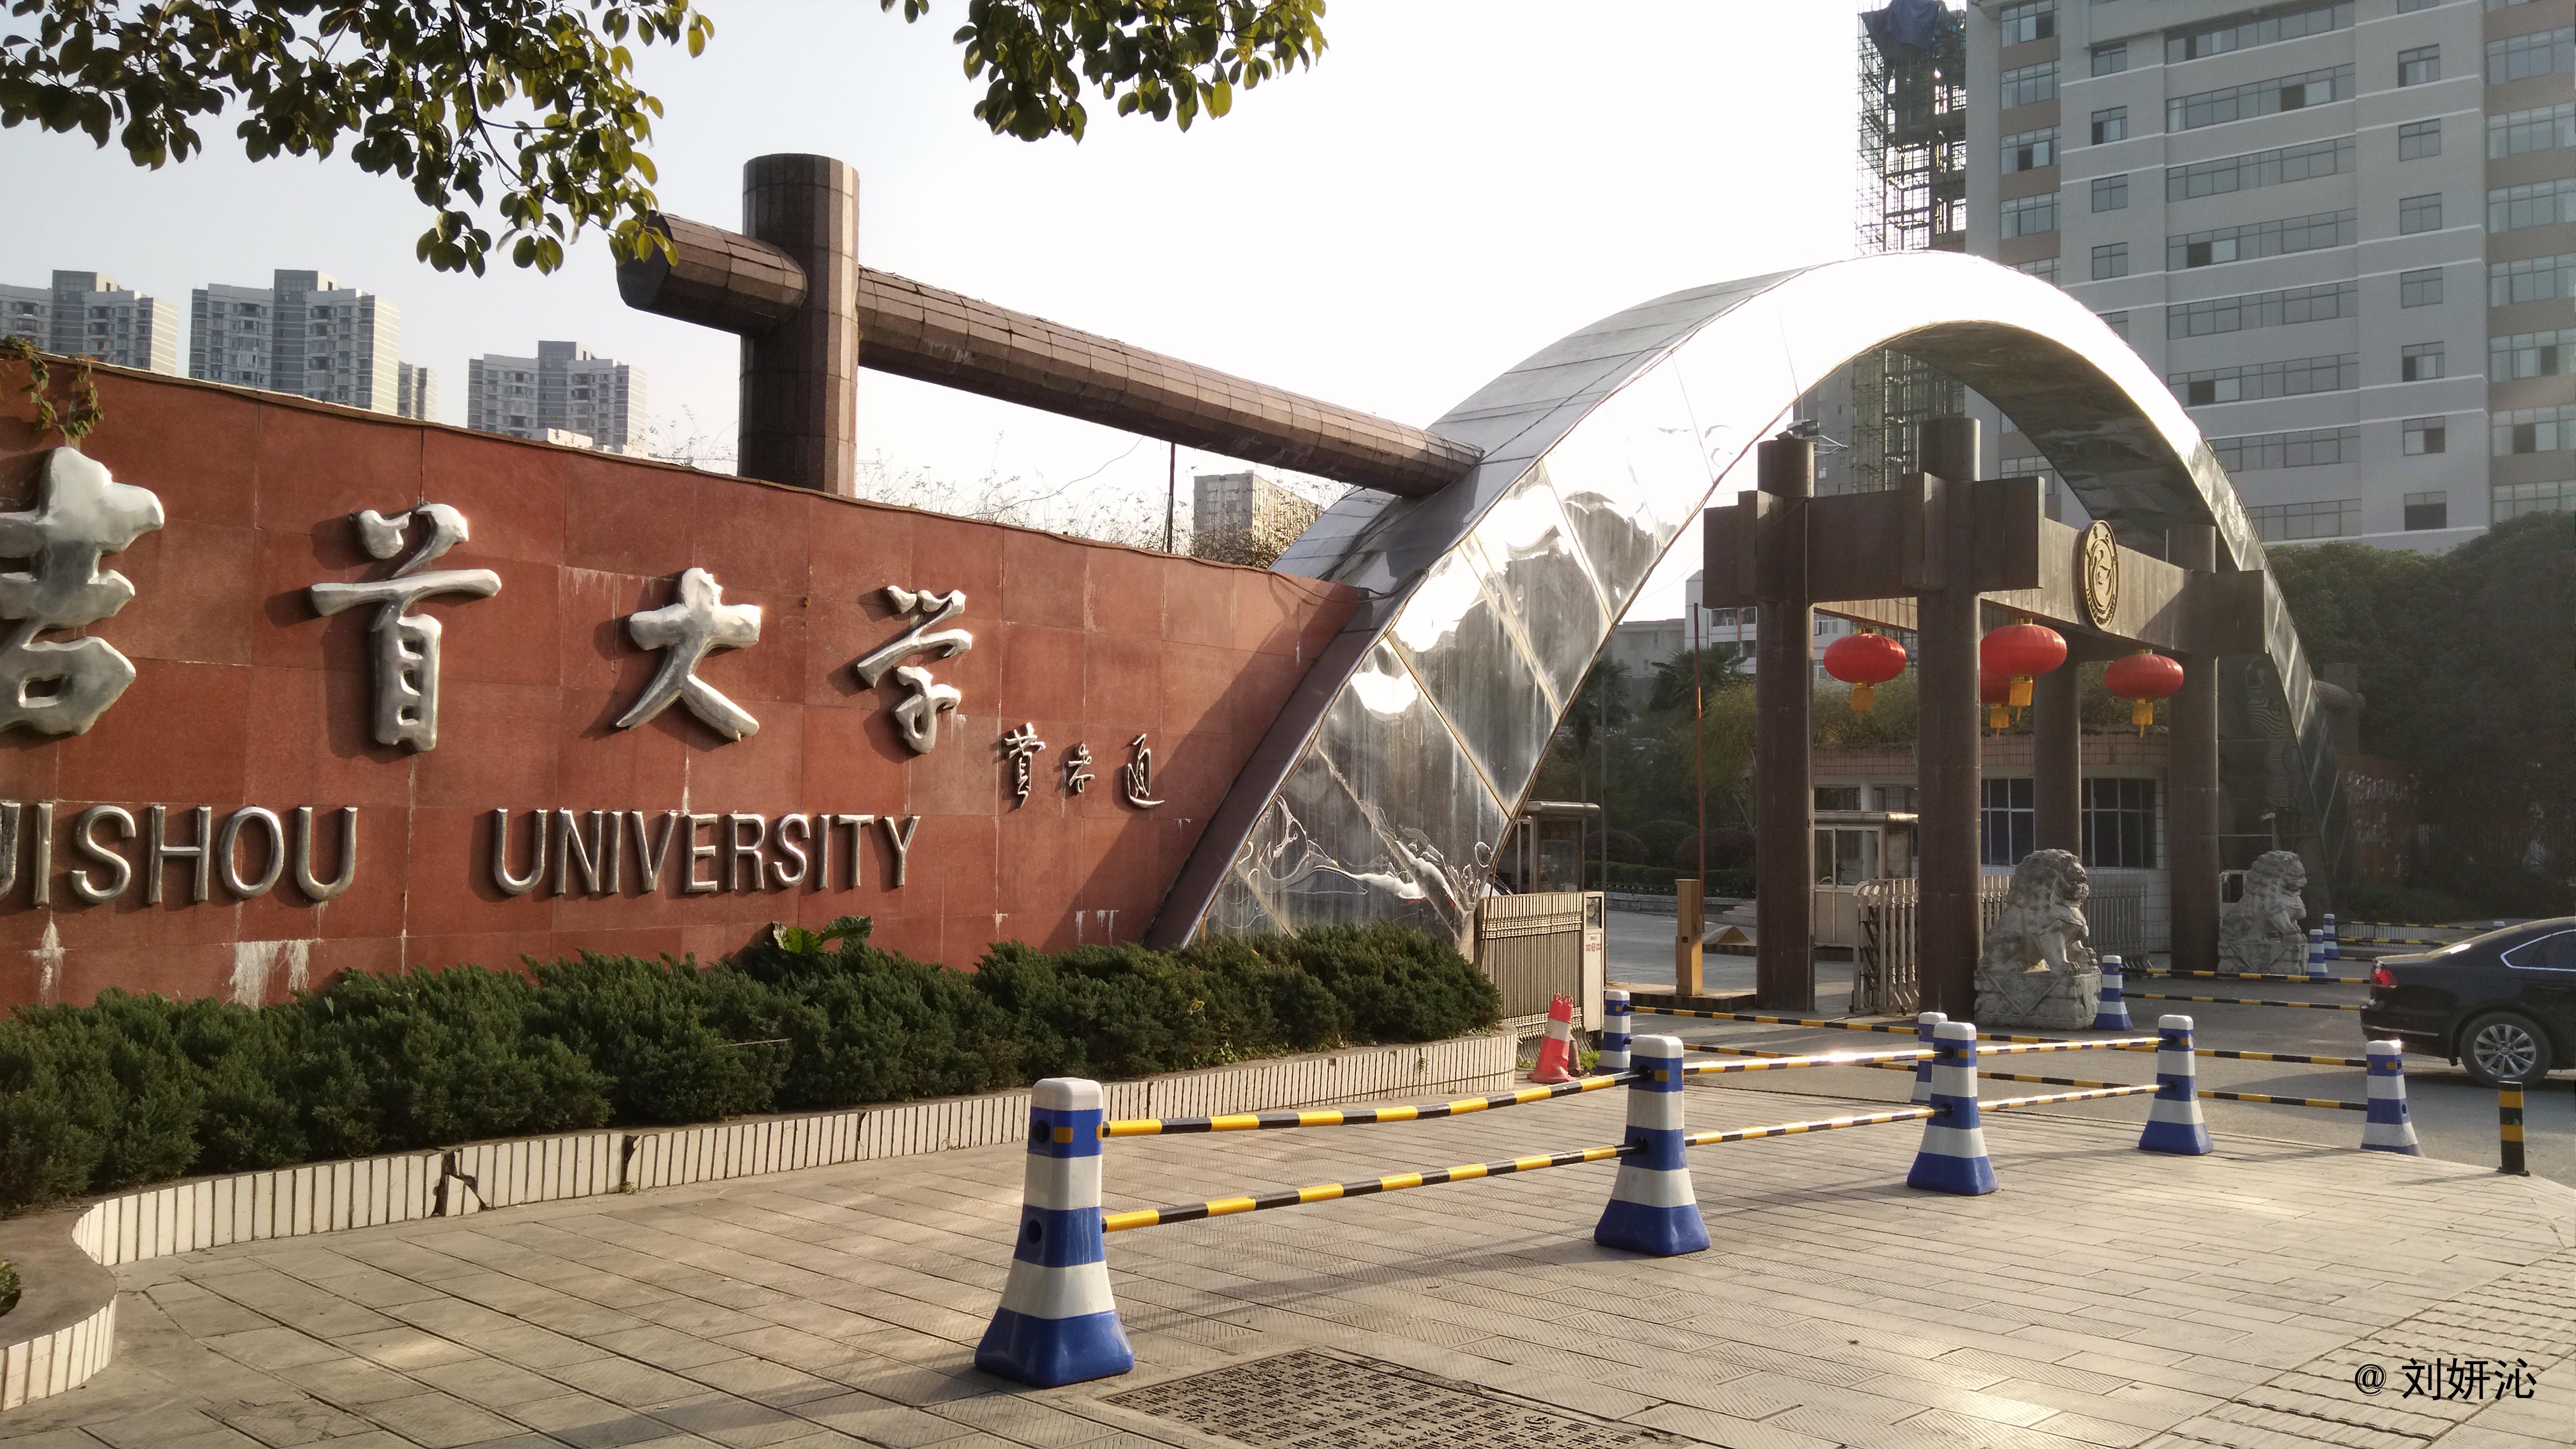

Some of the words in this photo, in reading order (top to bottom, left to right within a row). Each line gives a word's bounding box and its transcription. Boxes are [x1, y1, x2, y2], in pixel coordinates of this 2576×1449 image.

[0, 446, 973, 754] 吉首大学
[493, 808, 921, 896] UNIVERSITY
